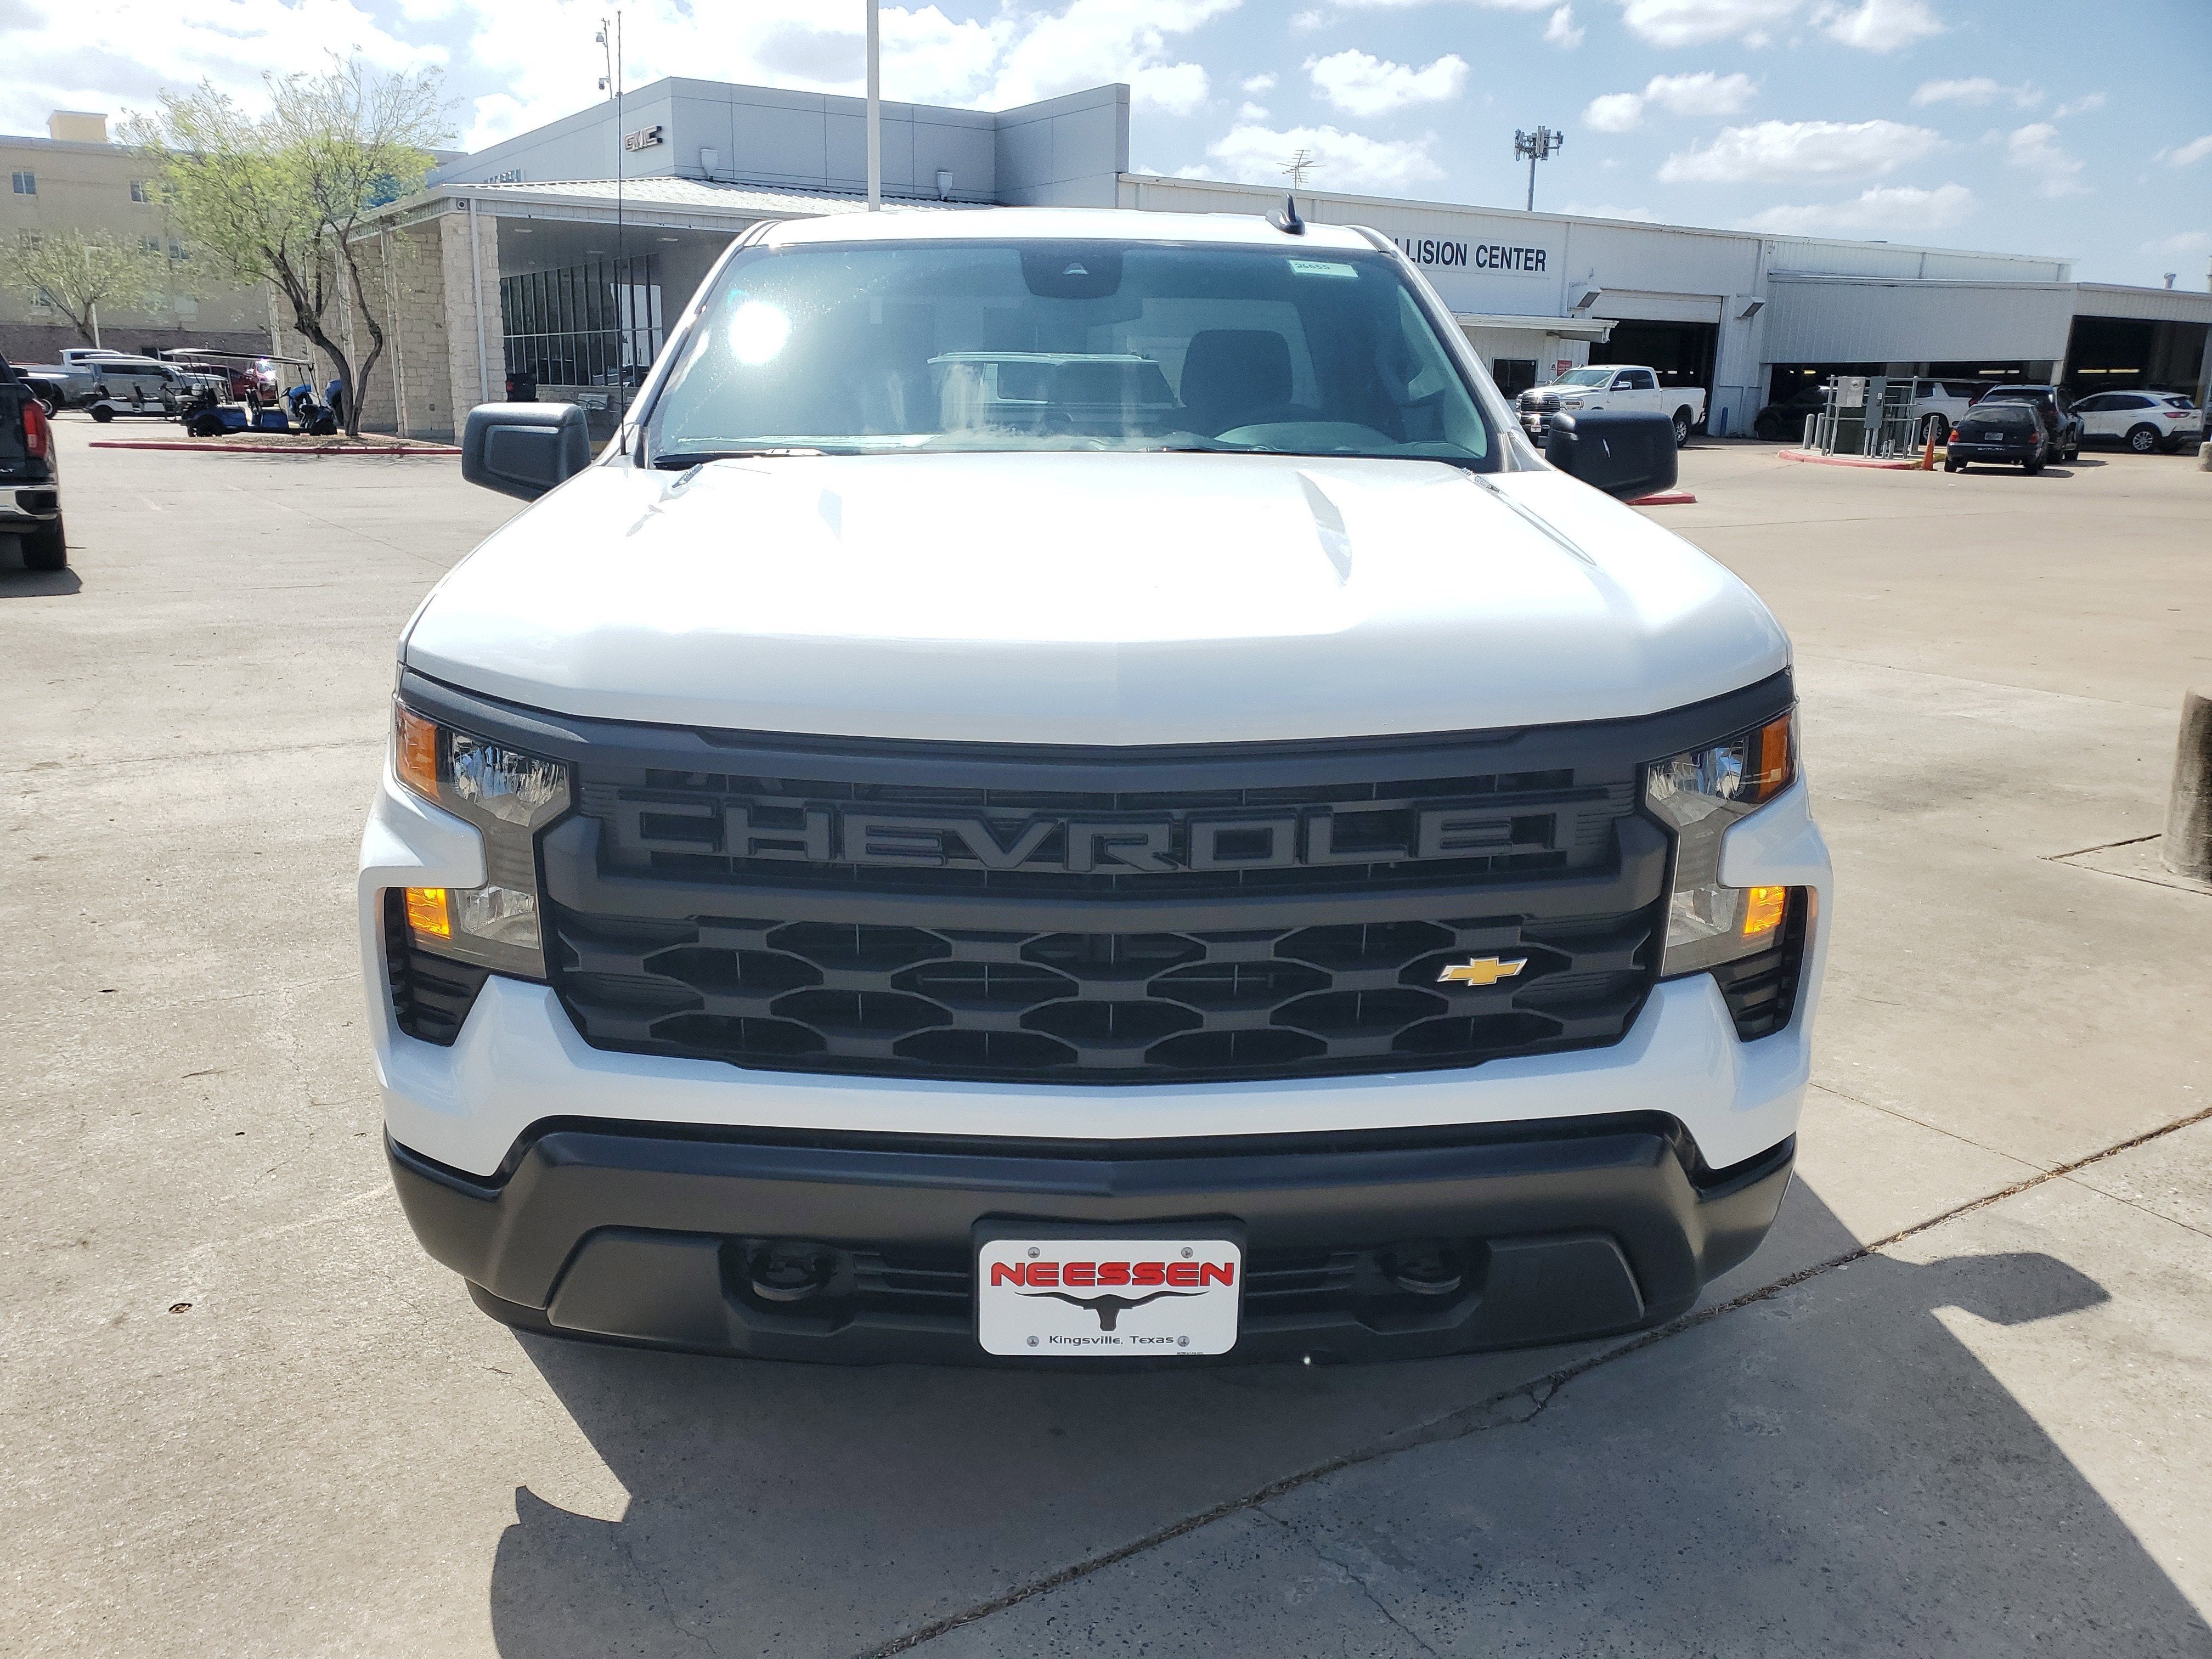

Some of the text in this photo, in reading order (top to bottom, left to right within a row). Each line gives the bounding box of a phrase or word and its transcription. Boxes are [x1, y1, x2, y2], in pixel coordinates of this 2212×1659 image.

[625, 125, 663, 151] GMC
[1395, 238, 1547, 272] LISION CENTER
[618, 788, 1612, 873] CHEVROLET
[991, 1262, 1234, 1286] NEESSEN
[1049, 1335, 1174, 1346] Kingsville, Texas
